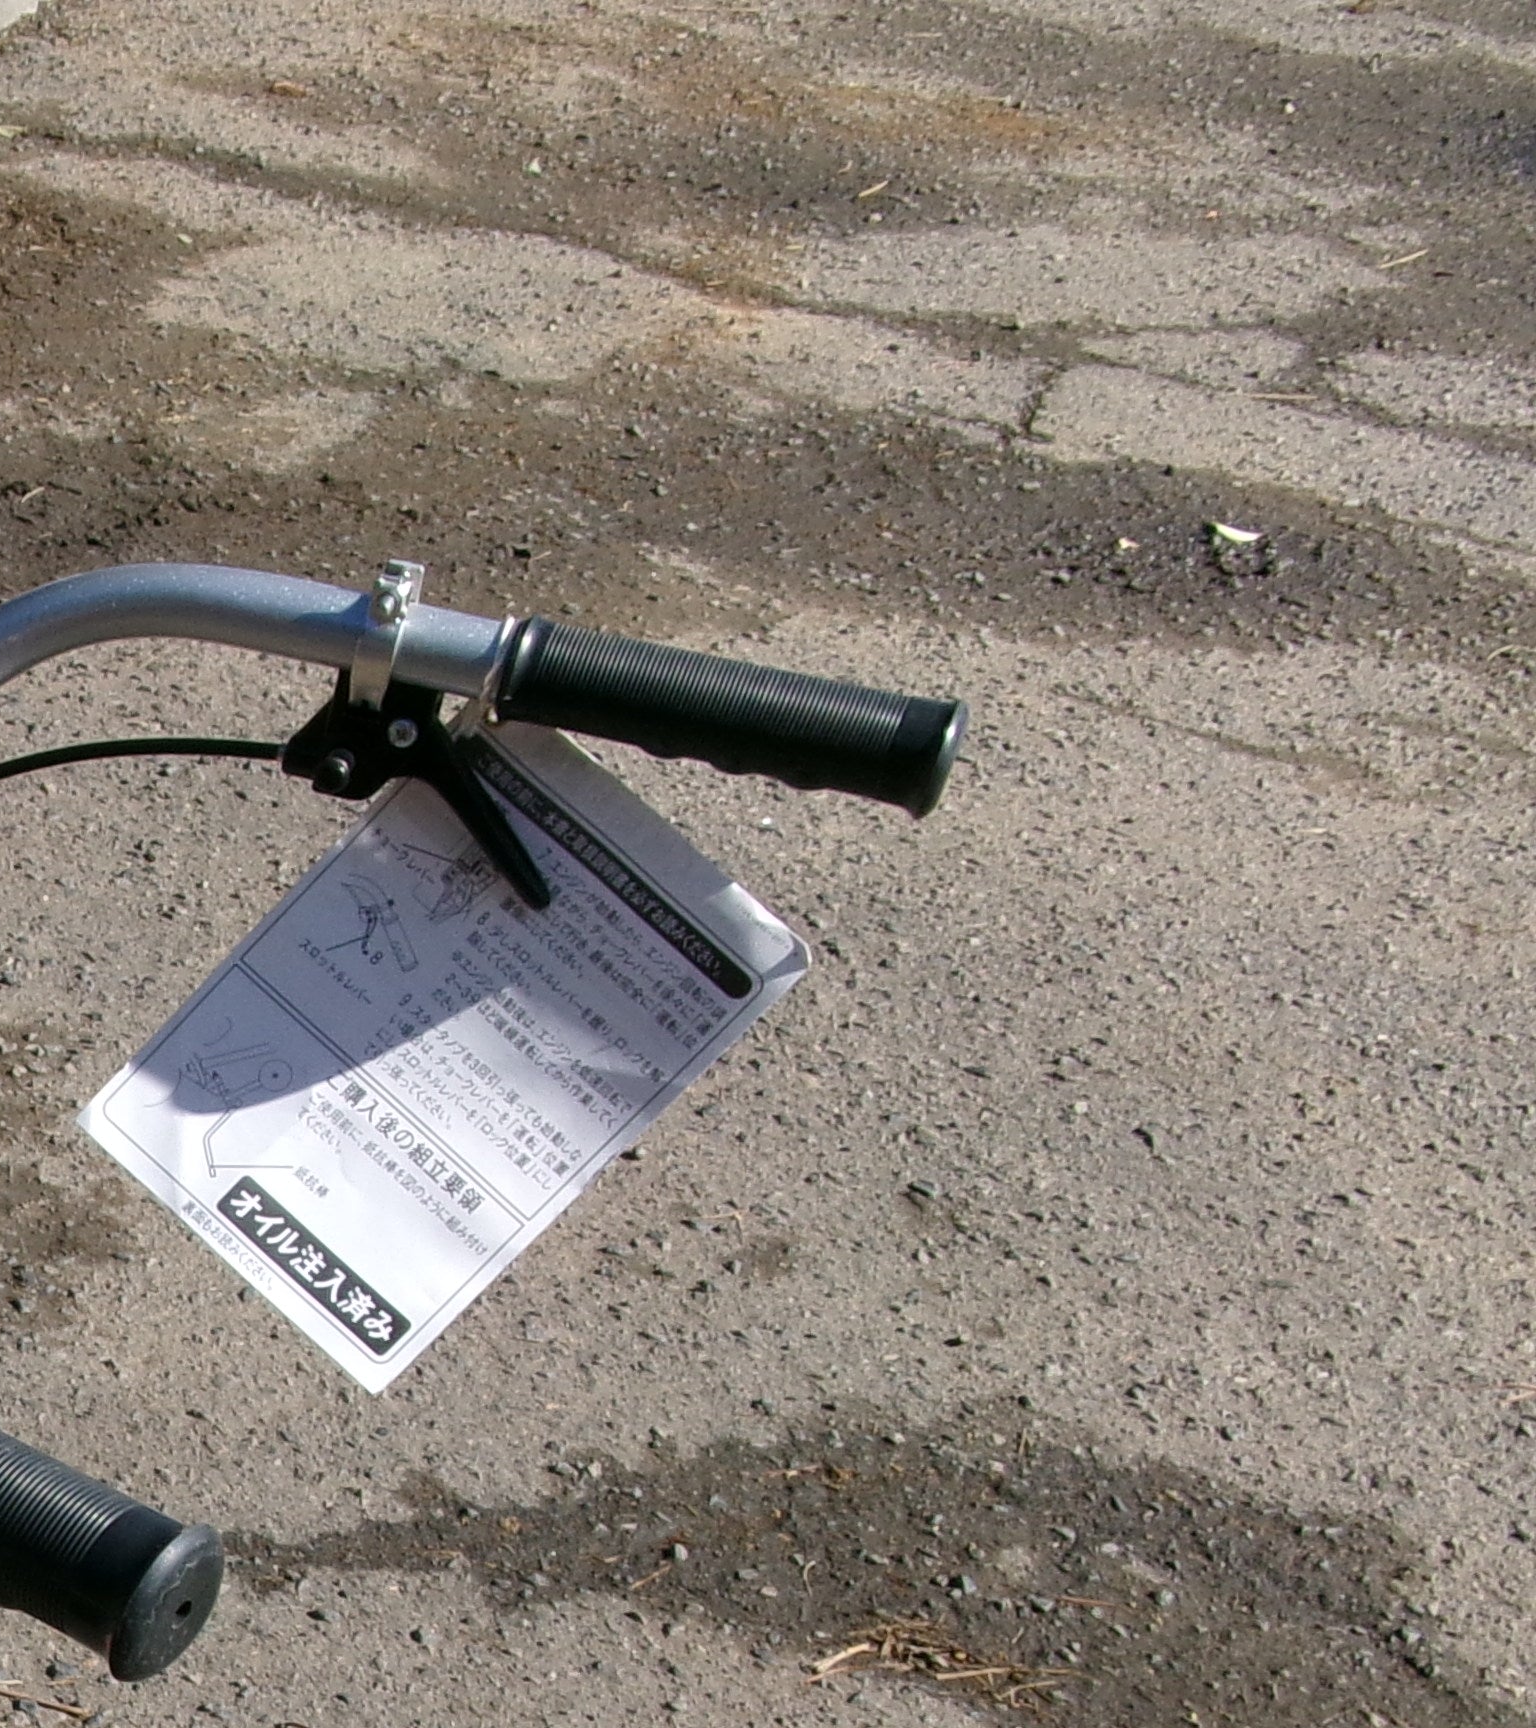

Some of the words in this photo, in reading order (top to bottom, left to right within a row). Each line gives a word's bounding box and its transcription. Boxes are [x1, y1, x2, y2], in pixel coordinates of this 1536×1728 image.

[324, 1067, 486, 1215] ご購入後の組立要領
[225, 1183, 402, 1348] オイル注入済み
